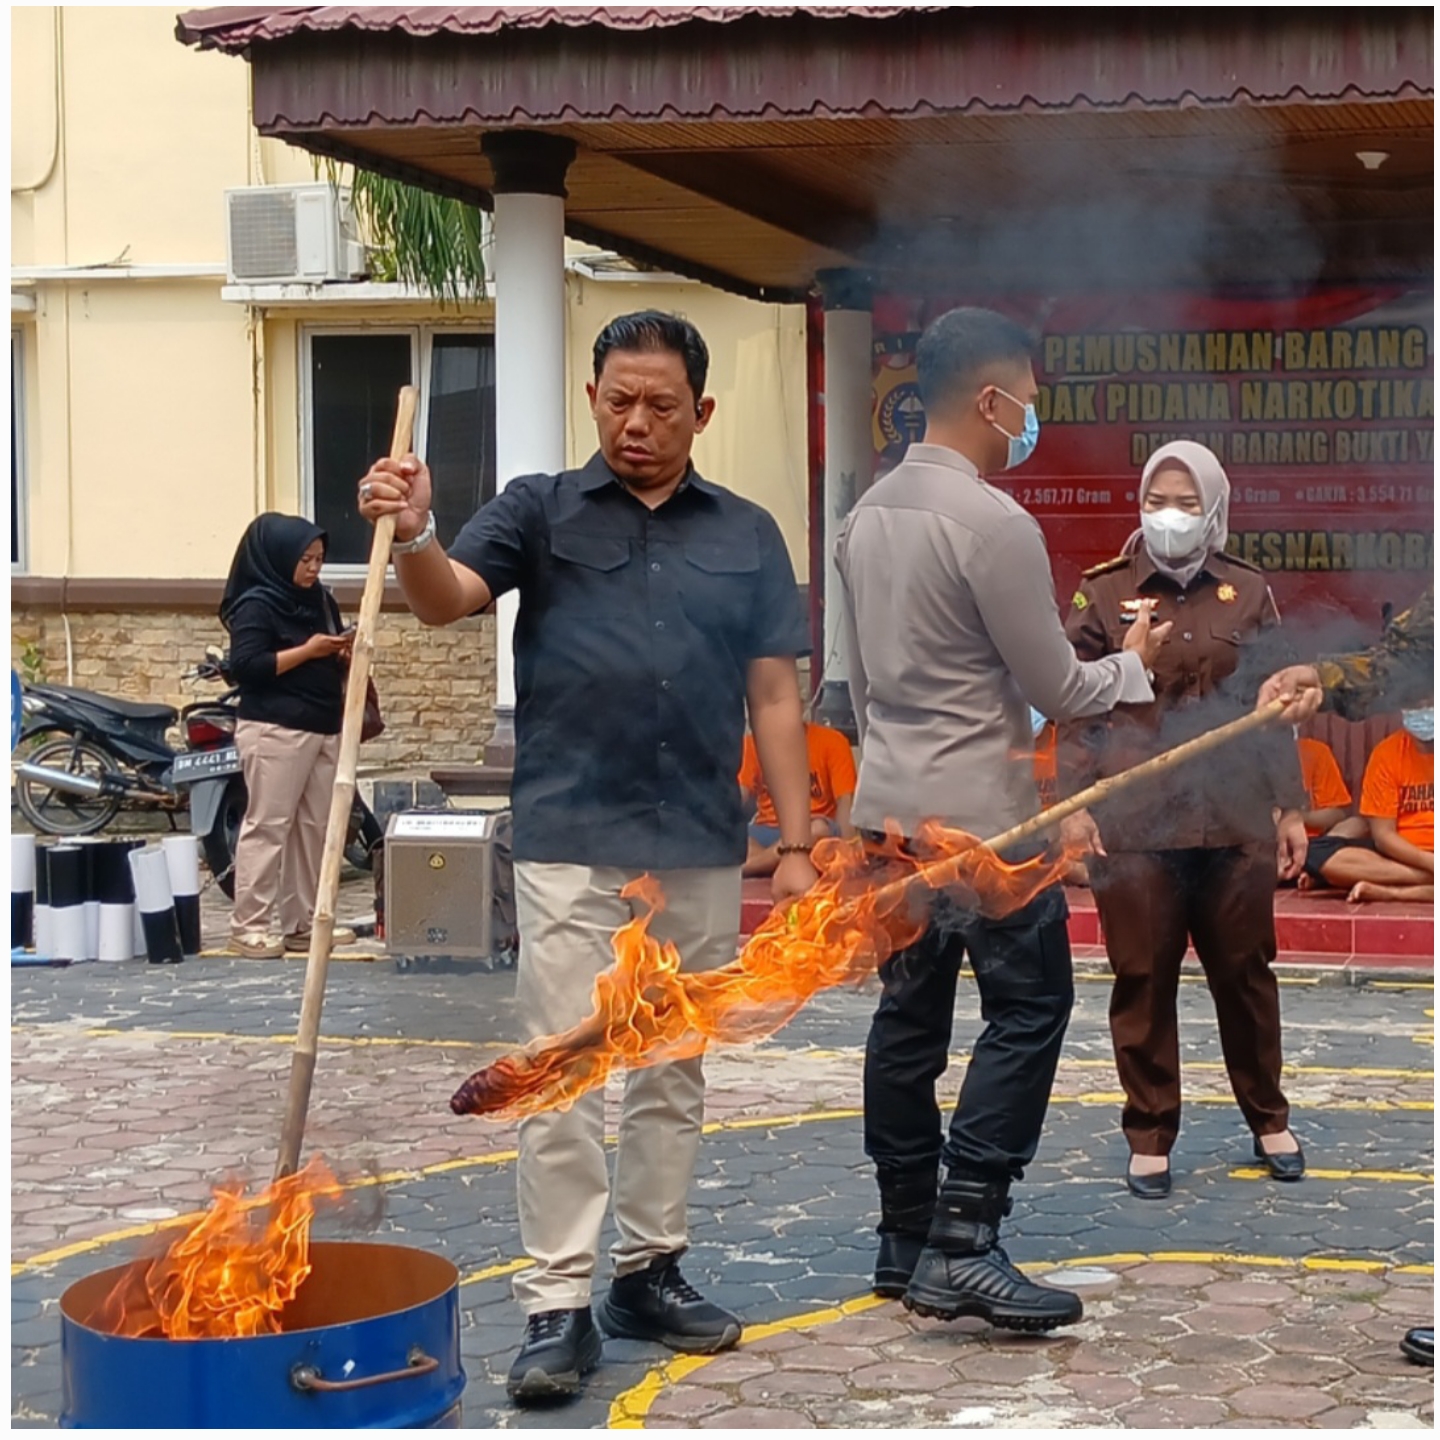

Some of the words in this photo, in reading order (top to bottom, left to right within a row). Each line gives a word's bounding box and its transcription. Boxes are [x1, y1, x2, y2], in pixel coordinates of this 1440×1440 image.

[1044, 331, 1273, 373] PEMUSNAHAN
[1284, 328, 1425, 371] BARANG
[1106, 382, 1231, 422] PIDANA
[1241, 378, 1434, 421] NARKOTIKA
[1233, 431, 1327, 464] BARANG
[1337, 429, 1409, 463] BUKTI
[1023, 487, 1074, 506] 2.567,77
[1076, 487, 1111, 504] Gram
[1245, 486, 1280, 503] Gram
